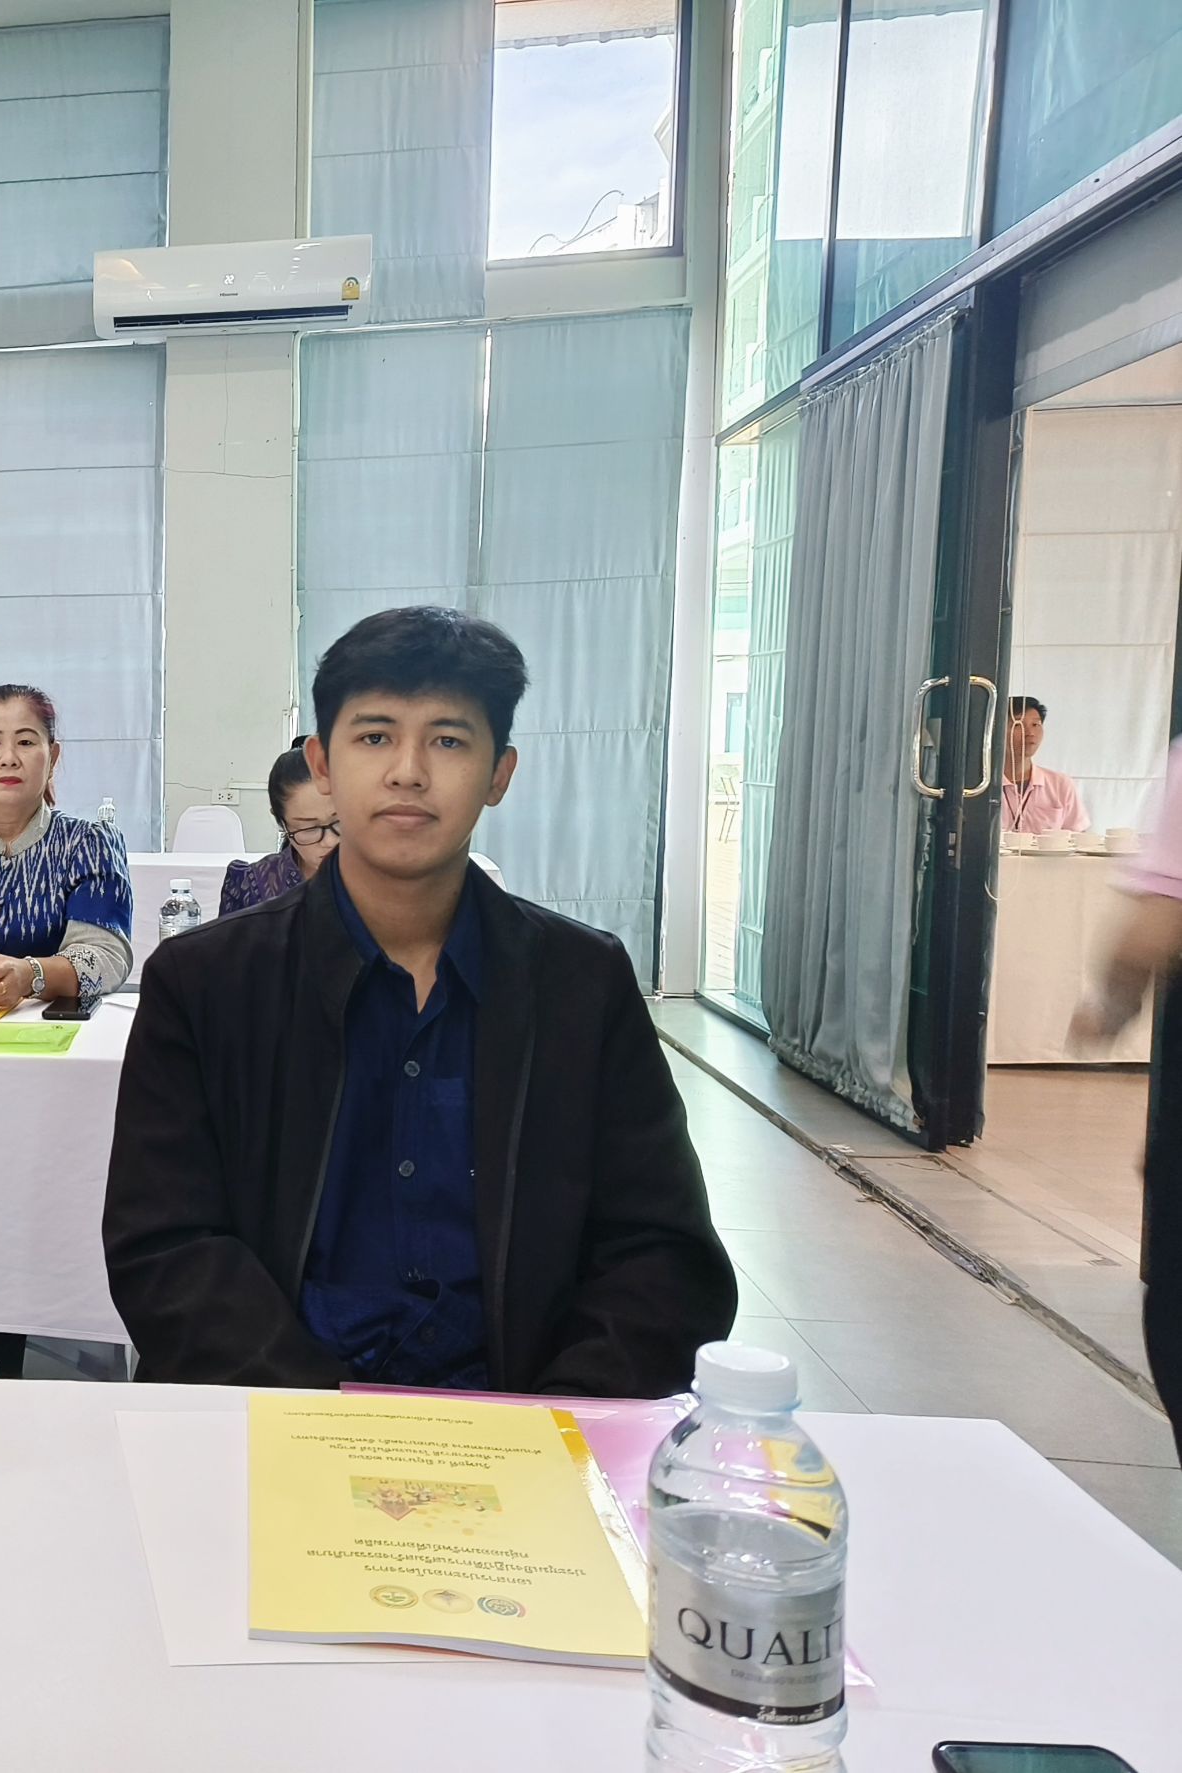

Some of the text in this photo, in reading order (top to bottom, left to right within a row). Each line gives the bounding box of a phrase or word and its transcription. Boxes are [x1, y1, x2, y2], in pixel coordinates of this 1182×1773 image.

[354, 1538, 529, 1560] กลุ่มออมทรัพย์เพื่อการผลิต
[307, 1550, 586, 1577] ประชุมเชิงปฏิบัติการเสริมสร้างธรรมาภิบาล
[364, 1565, 532, 1586] เอกสารประกอบโครงการ
